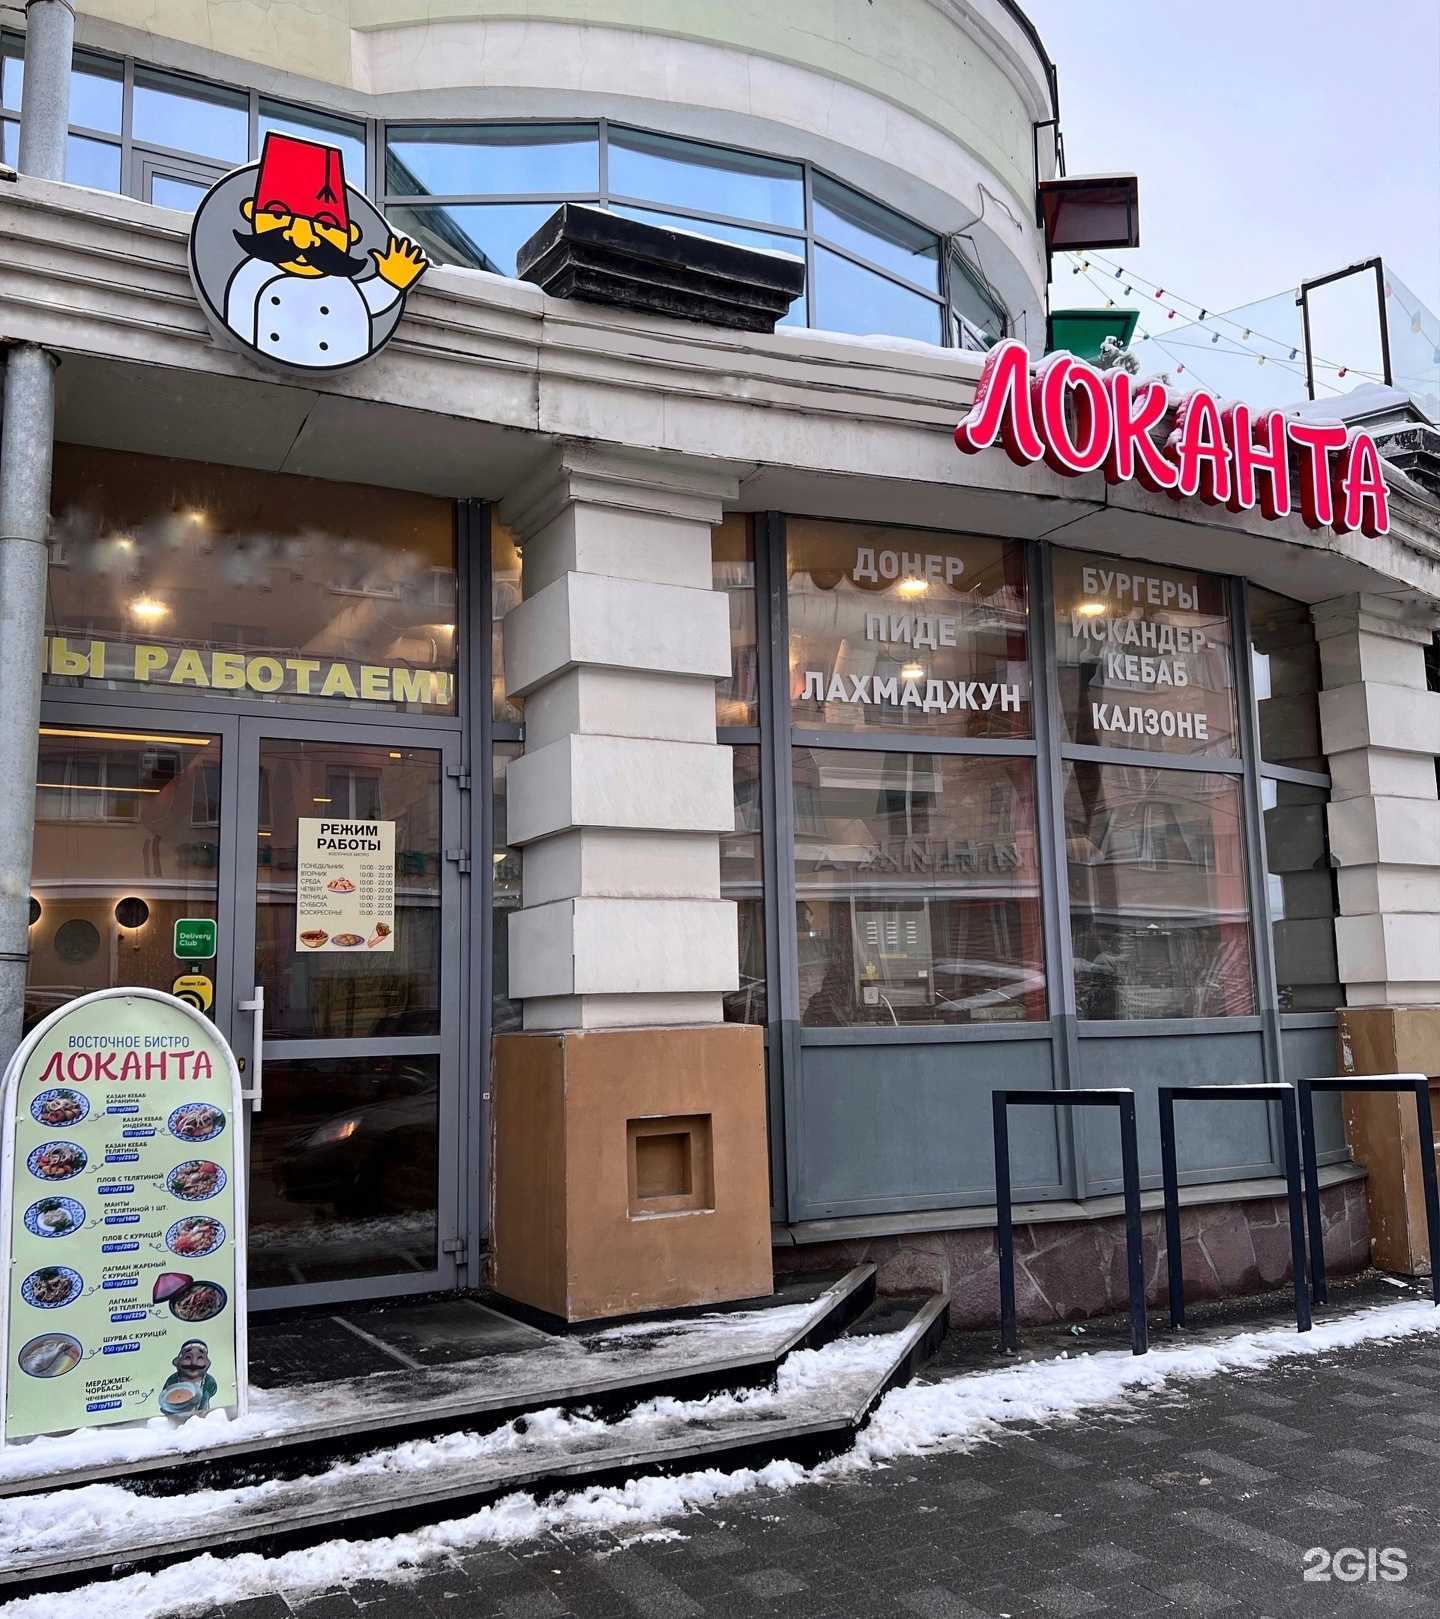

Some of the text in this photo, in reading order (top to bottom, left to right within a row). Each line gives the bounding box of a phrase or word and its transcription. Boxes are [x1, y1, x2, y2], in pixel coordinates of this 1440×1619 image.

[958, 341, 1390, 537] ЛОКАНТА
[853, 547, 965, 584] ДОНЕР
[1082, 567, 1199, 611] БУРГЕРЫ
[864, 612, 957, 650] ПИДЕ
[1071, 611, 1217, 655] ИСКАНДЕР-
[42, 637, 454, 706] Ы РАБОТАЕМ!
[1107, 652, 1189, 687] КЕБАБ
[801, 671, 1021, 714] ЛАХМАДЖУН
[1092, 702, 1209, 740] КАЛЗОНЕ
[320, 823, 378, 836] РЕЖИМ
[317, 838, 381, 851] РАБОТЫ
[180, 932, 211, 941] Delivery
[69, 1036, 190, 1048] ВОСТОЧНОЕ БИСТРО
[39, 1050, 213, 1082] ЛОКАНТА
[124, 1174, 164, 1182] ТЕЛЯТИНОЙ
[110, 1206, 150, 1214] ТЕЛЯТИНОЙ
[130, 1231, 162, 1239] КУРИЦЕЙ
[132, 1260, 166, 1269] ЖАРЕНЫЙ
[119, 1303, 155, 1311] ТЕЛЯТИНЫ
[135, 1328, 167, 1338] КУРИЦЕЙ
[85, 1376, 133, 1387] МЕРДЖМЕК-
[85, 1384, 122, 1394] ЧОРБАСЫ
